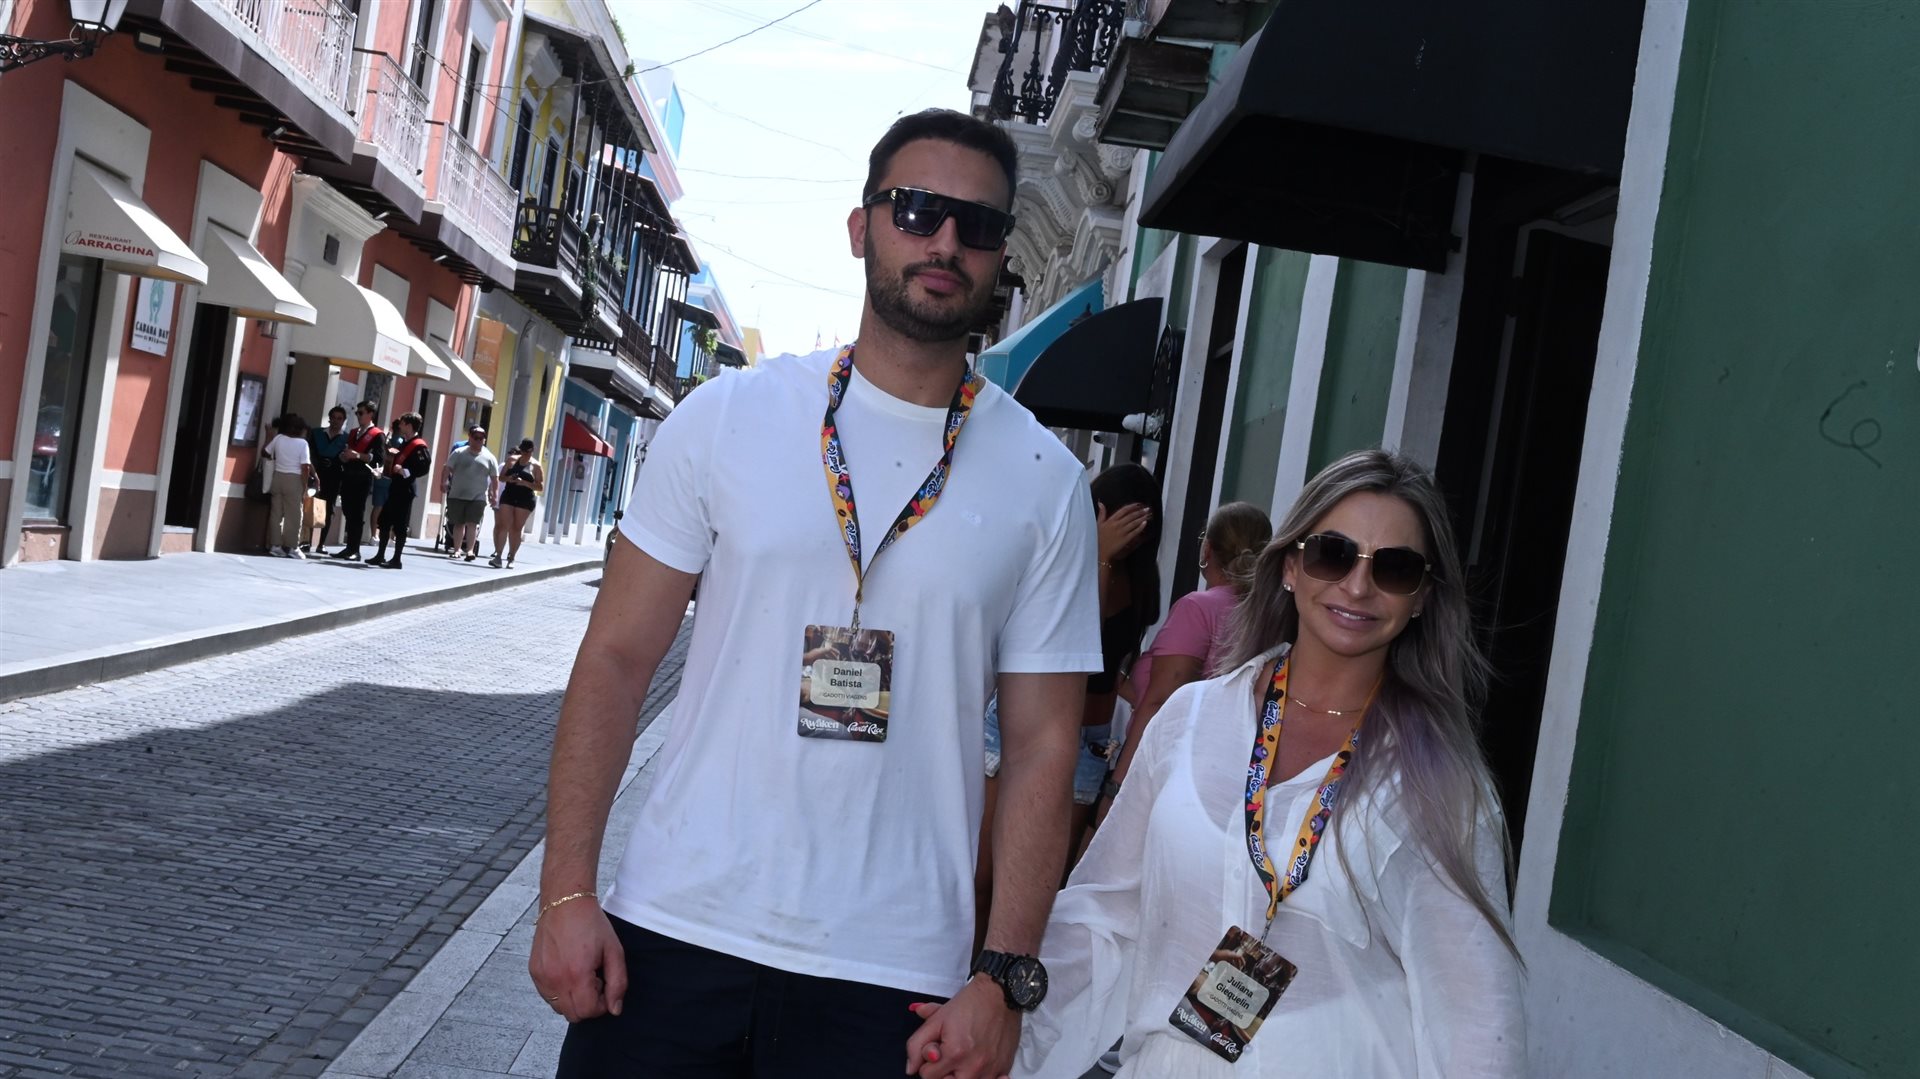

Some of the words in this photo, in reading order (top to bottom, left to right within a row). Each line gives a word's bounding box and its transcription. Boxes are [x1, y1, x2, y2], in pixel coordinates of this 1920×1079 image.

[88, 233, 132, 244] RESTAURANT
[834, 667, 863, 677] Daniel
[830, 678, 863, 688] Batista
[800, 718, 839, 731] Awaken
[1227, 976, 1254, 998] Juliana
[1177, 1007, 1208, 1032] Awaken
